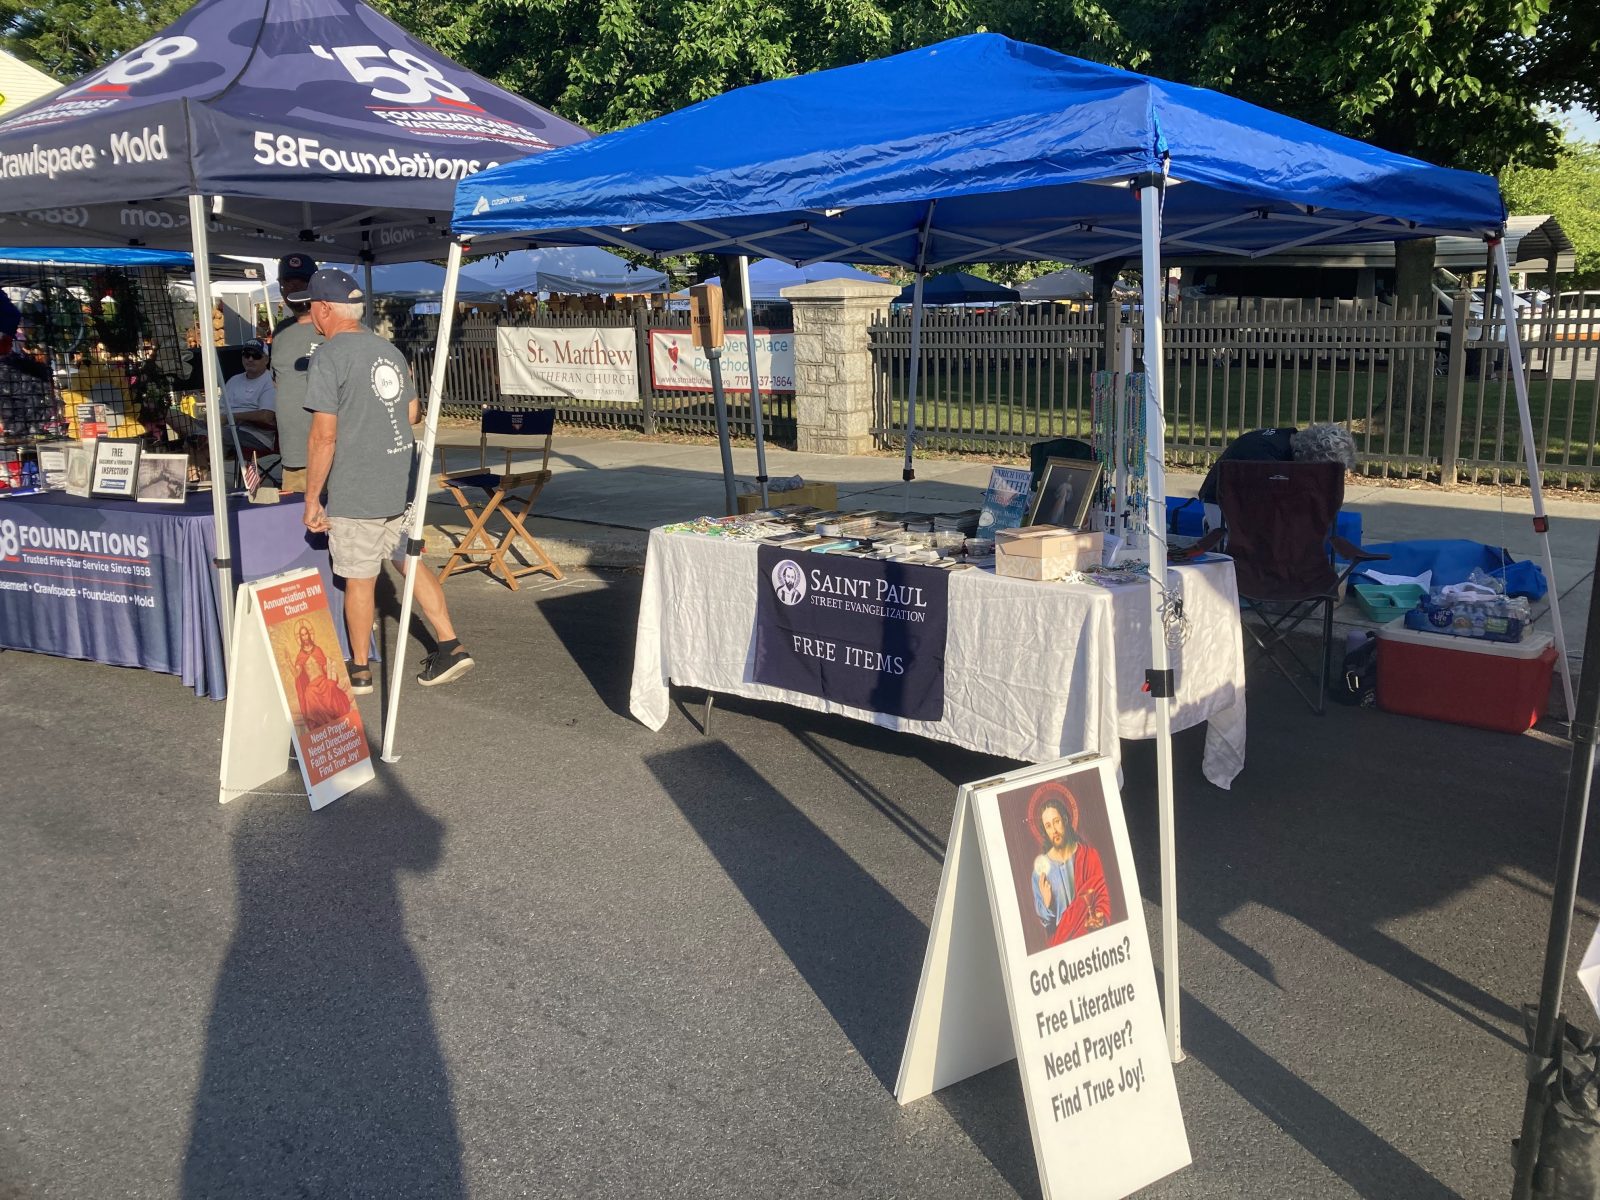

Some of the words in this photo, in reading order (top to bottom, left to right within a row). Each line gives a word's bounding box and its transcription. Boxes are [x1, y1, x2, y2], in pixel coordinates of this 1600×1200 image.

[372, 110, 519, 132] FOUNDATIONS
[387, 119, 549, 144] WATERPROOFING
[111, 125, 168, 165] Mold
[527, 339, 549, 363] St.
[553, 339, 633, 366] Matthew
[755, 338, 788, 352] Place
[694, 357, 749, 372] Prechoo
[585, 373, 636, 386] CHURCH
[735, 375, 793, 387] 71737-1864
[111, 447, 124, 457] FREE
[101, 466, 129, 475] INSPECTIONS
[19, 525, 149, 557] FOUNDATIONS
[23, 554, 49, 566] Trusted
[50, 556, 81, 569] Five-Star
[82, 560, 109, 573] Service
[111, 563, 132, 575] Since
[133, 565, 151, 577] 1958
[34, 582, 76, 598] Crawlspace
[82, 588, 128, 604] Foundation
[134, 595, 155, 608] Mold
[263, 591, 306, 611] Annunciation
[306, 584, 322, 597] BVM
[811, 569, 870, 599] SAINT
[876, 578, 927, 607] PAUL
[284, 601, 308, 616] Church
[811, 594, 843, 610] STREET
[845, 601, 925, 622] EVANGELIZATION
[792, 635, 836, 661] FREE
[845, 646, 904, 675] ITEMS
[308, 741, 324, 757] Need
[325, 725, 357, 750] Directions?
[310, 727, 327, 744] Need
[328, 717, 350, 736] Prayer?
[310, 754, 327, 769] Faith
[333, 736, 361, 758] Salvation!
[318, 764, 334, 778] Find
[334, 757, 347, 769] True
[348, 749, 360, 763] Joy!
[1030, 965, 1057, 996] Got
[1058, 935, 1131, 985] Questions?
[1035, 1008, 1069, 1039] Free
[1069, 982, 1135, 1025] Literature
[1043, 1042, 1081, 1081] Need
[1083, 1019, 1134, 1064] Prayer?
[1051, 1085, 1082, 1123] Find
[1083, 1077, 1115, 1107] True
[1118, 1058, 1146, 1093] Joy!
